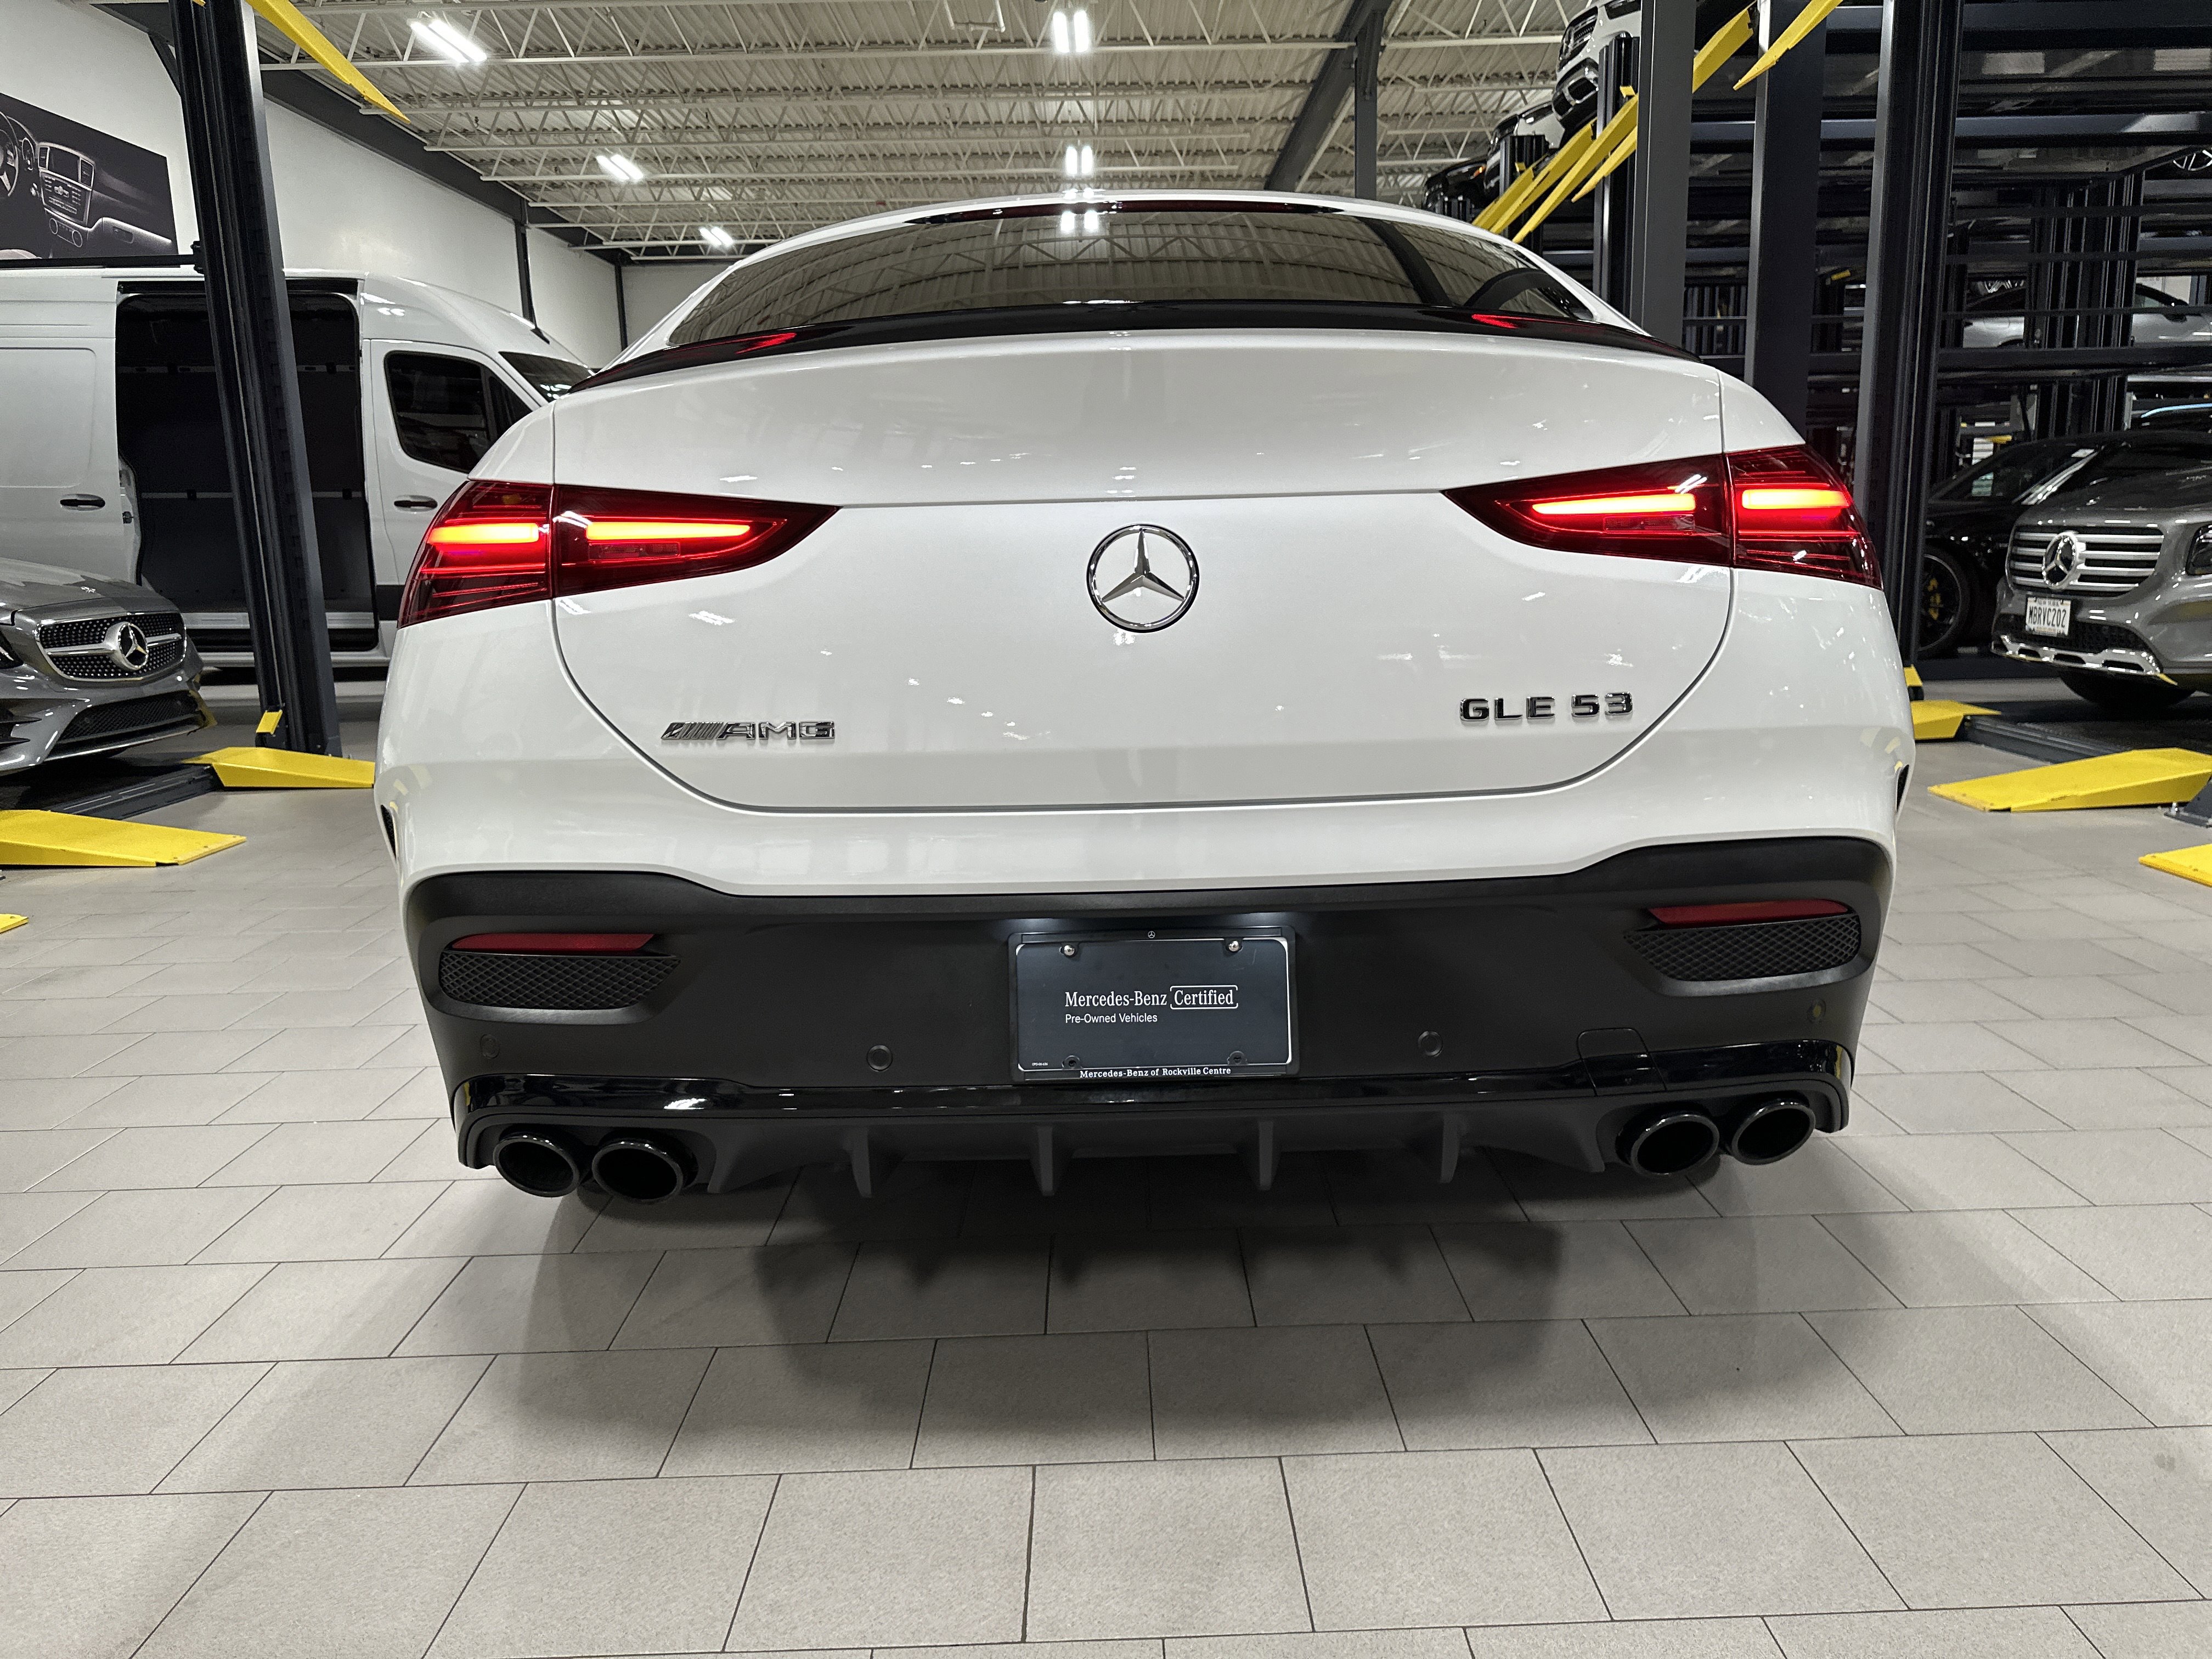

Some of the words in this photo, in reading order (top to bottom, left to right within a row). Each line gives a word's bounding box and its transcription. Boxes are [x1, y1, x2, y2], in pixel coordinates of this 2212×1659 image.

[1460, 696, 1555, 721] GLE
[1571, 692, 1633, 716] 53
[715, 721, 835, 740] AMG
[1065, 991, 1167, 1007] Mercedes-Benz
[1174, 989, 1234, 1006] Certified
[1065, 1013, 1116, 1024] Pre-Owned
[1119, 1012, 1158, 1023] Vehicles
[1080, 1069, 1149, 1078] Mercedes-Benz
[1162, 1067, 1201, 1076] Rockville
